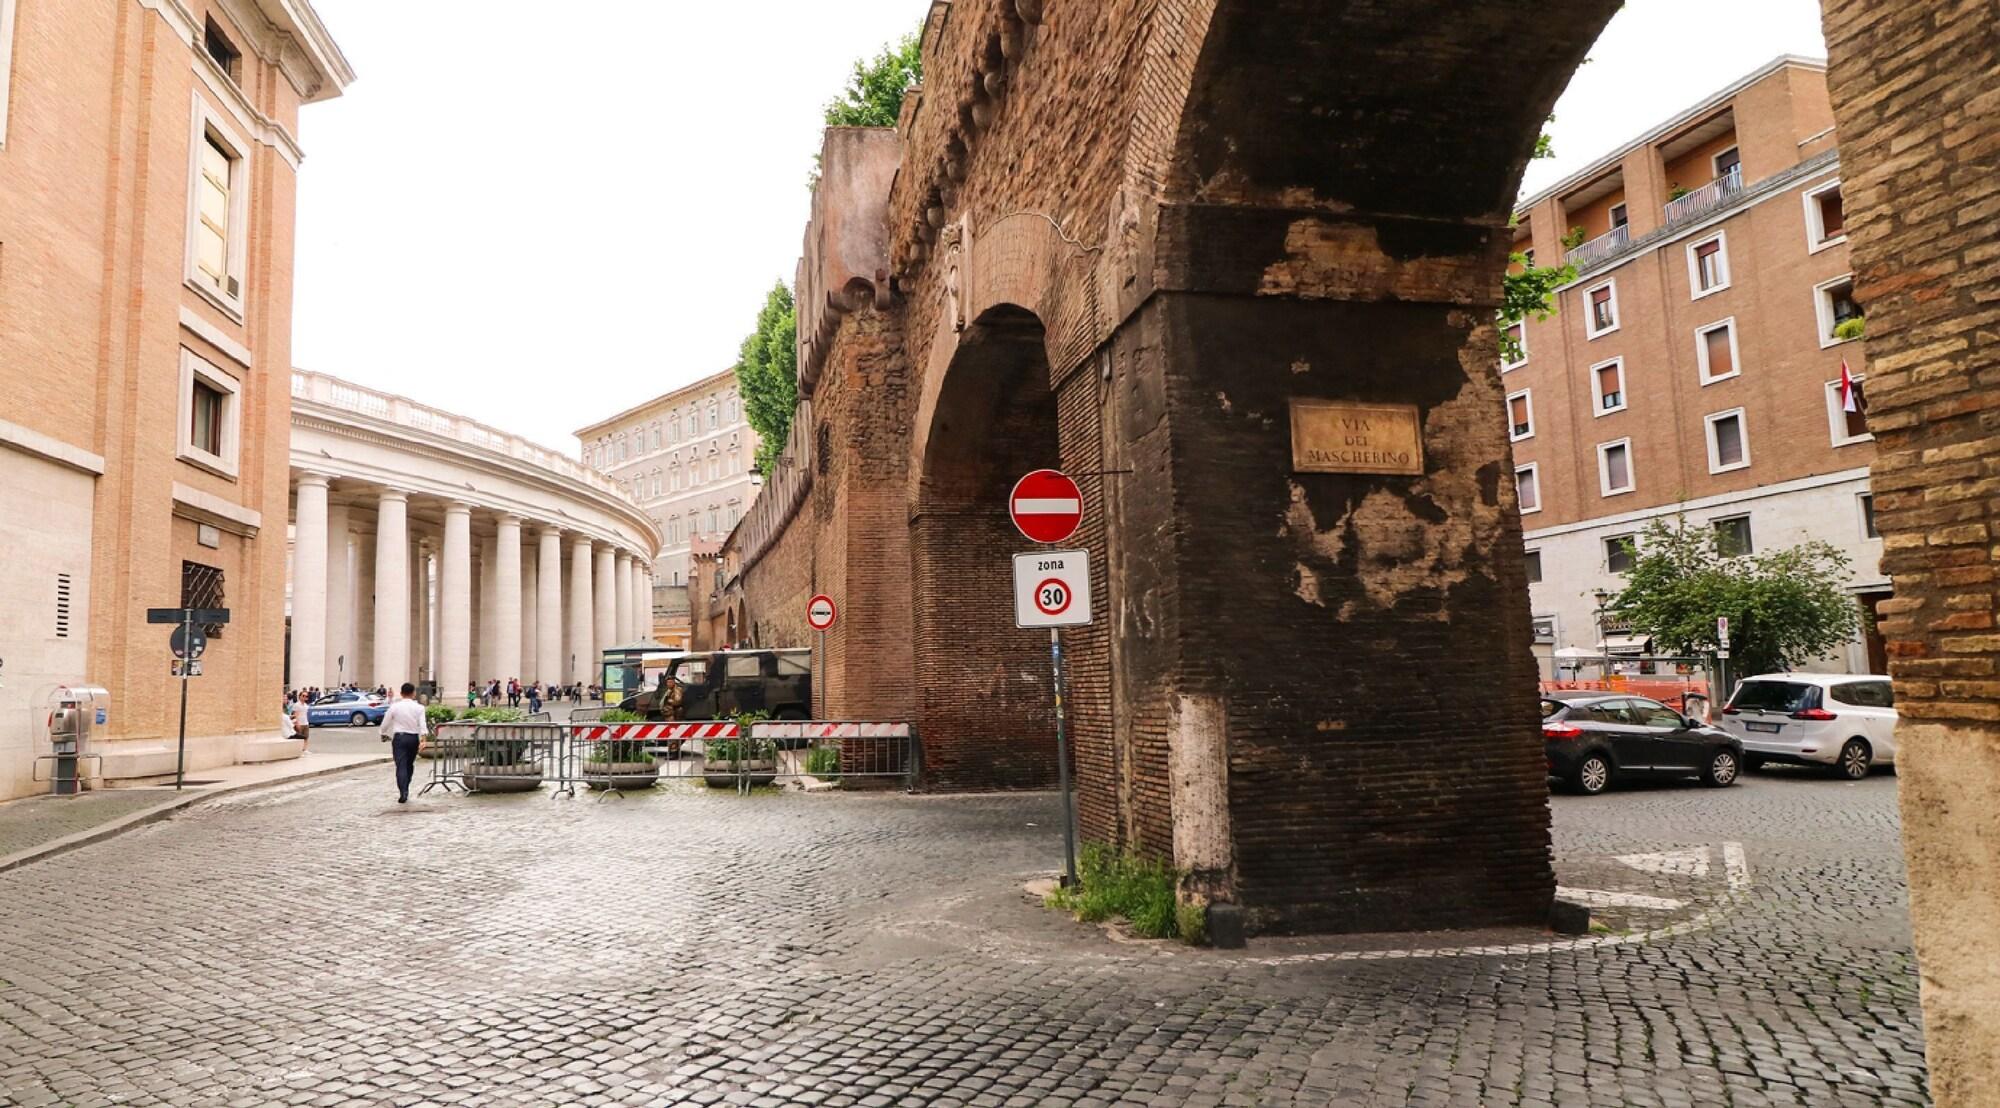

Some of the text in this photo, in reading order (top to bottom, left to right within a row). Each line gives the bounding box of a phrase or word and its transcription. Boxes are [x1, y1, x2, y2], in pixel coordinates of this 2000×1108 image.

[1342, 418, 1370, 431] VIA
[1308, 450, 1410, 465] MASCHERINO
[1038, 560, 1064, 571] zona
[1042, 588, 1063, 606] 30
